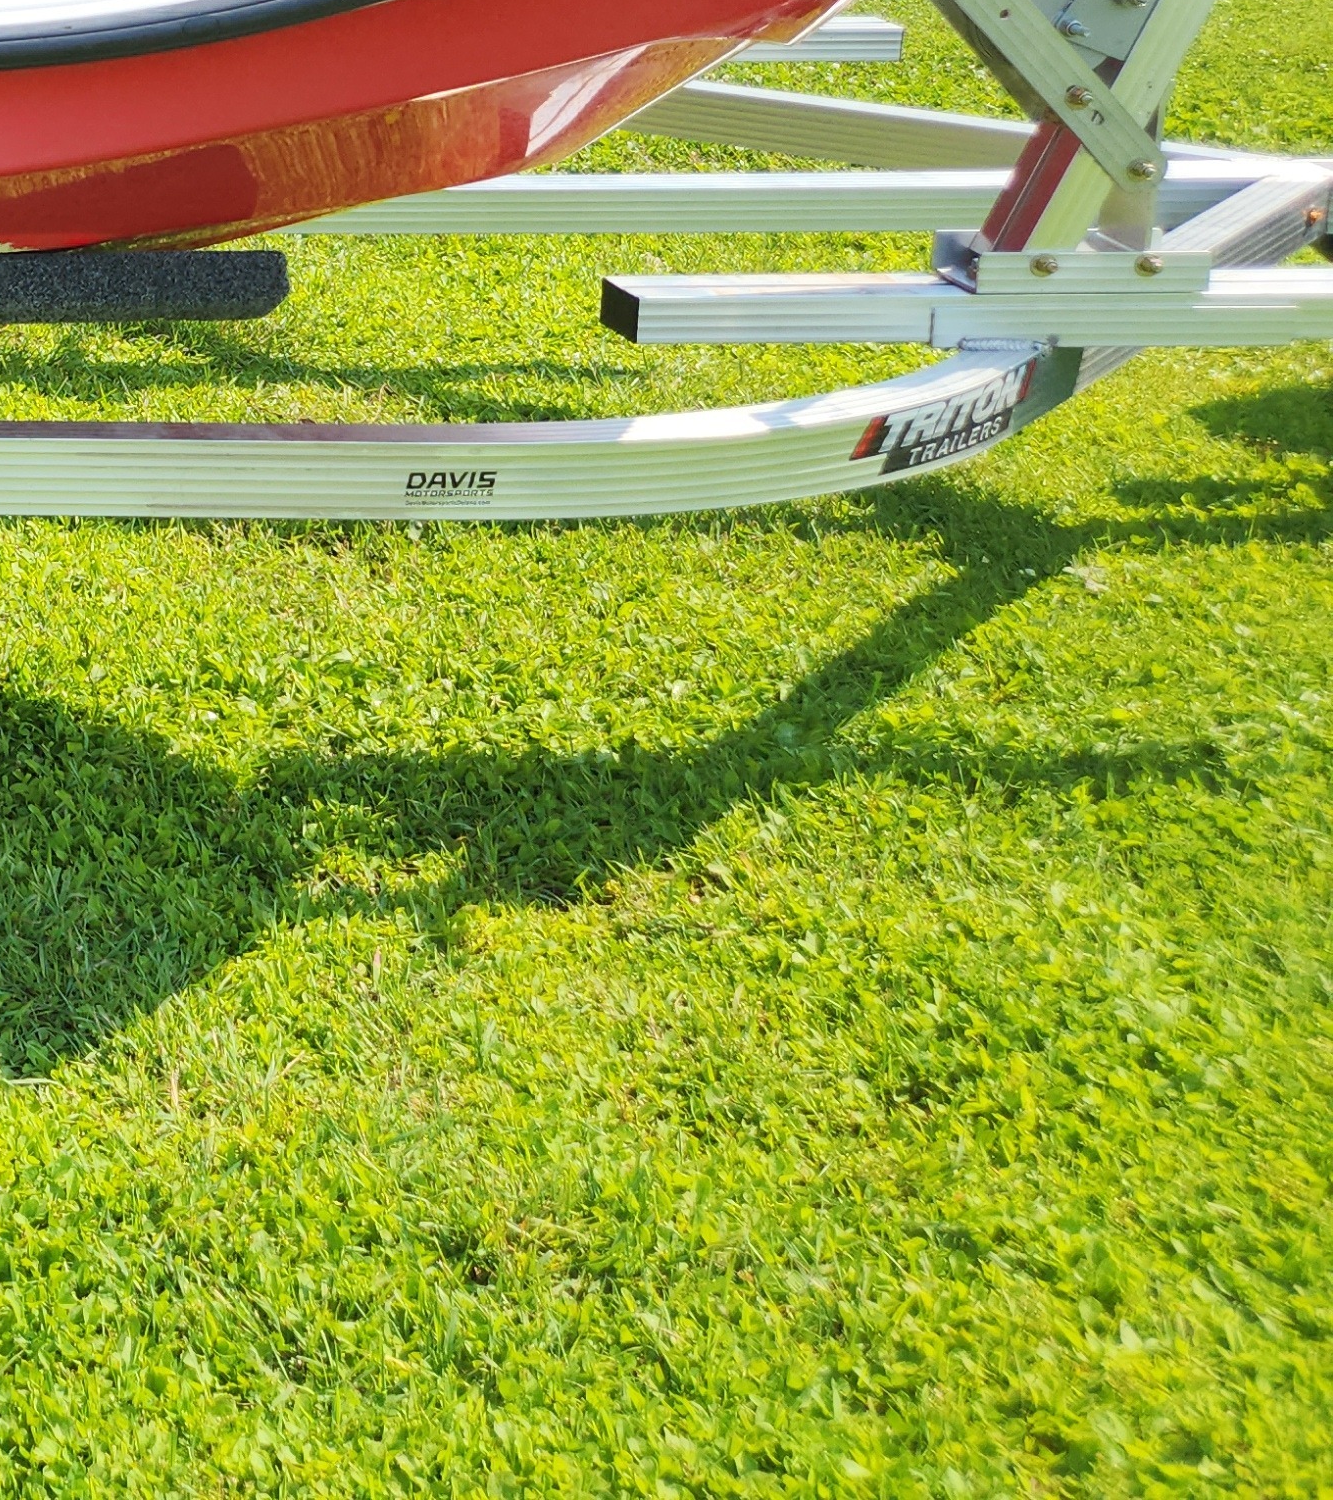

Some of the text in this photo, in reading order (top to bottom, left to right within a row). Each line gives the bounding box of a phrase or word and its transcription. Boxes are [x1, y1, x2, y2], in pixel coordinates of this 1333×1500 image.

[878, 364, 1027, 453] TRITON
[909, 416, 1002, 466] TRAILERS
[404, 489, 493, 497] MOTORSPORTS
[406, 471, 497, 489] DAVIS
